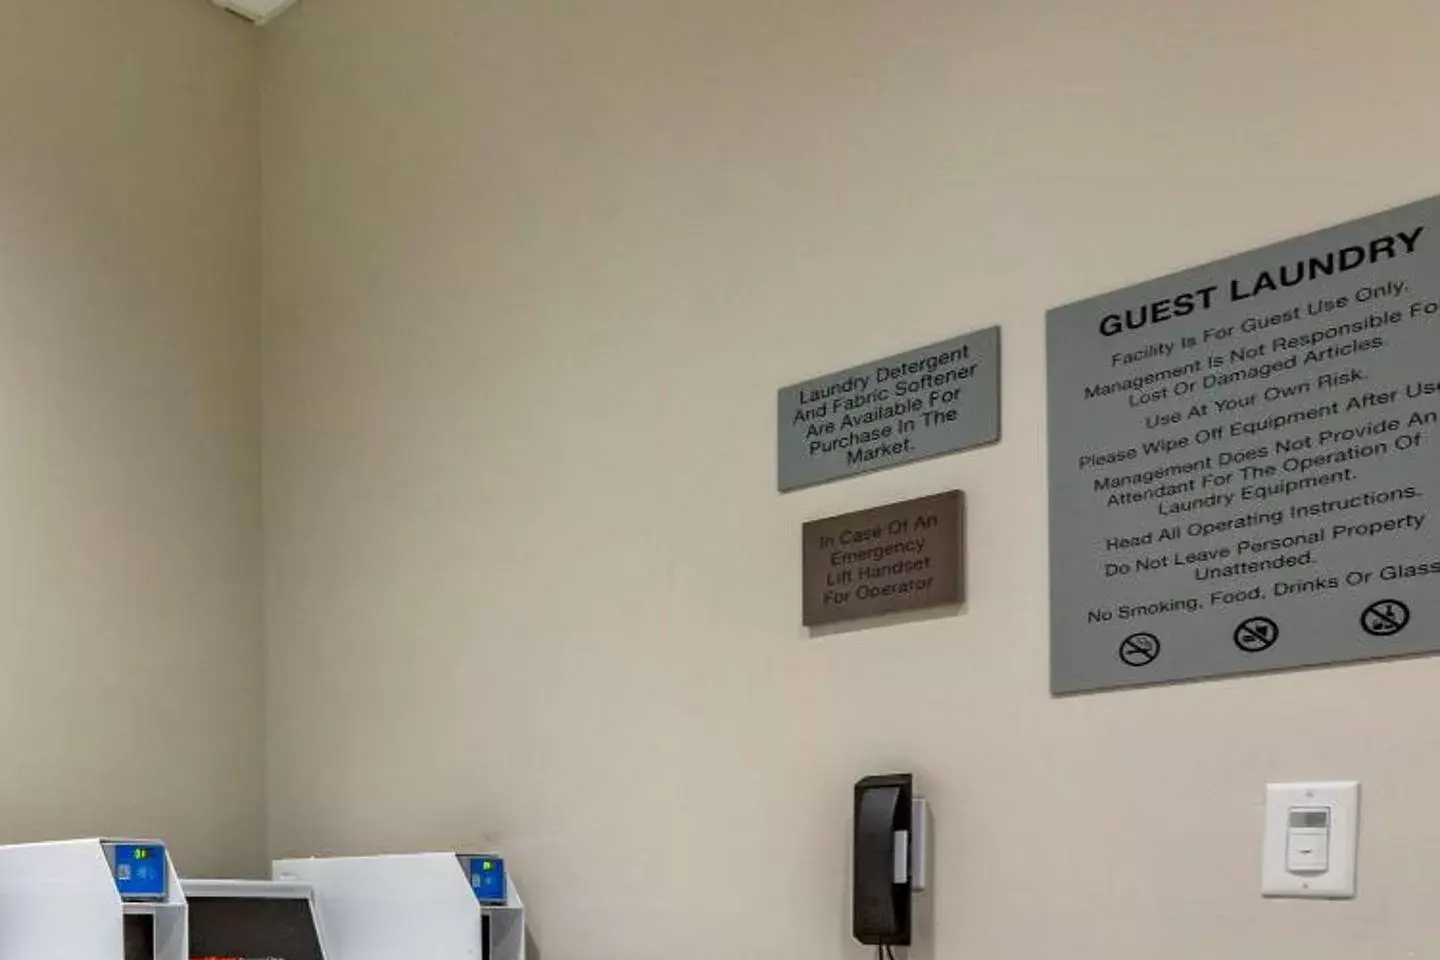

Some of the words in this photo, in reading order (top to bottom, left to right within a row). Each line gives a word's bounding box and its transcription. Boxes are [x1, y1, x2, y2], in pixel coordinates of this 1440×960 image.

[1099, 286, 1217, 337] GUEST
[1230, 226, 1424, 301] LAUNDRY
[1084, 359, 1203, 400] Management
[1207, 354, 1225, 369] Is
[1230, 345, 1265, 365] Not
[1272, 308, 1403, 353] Responsible
[1409, 297, 1440, 317] Fo
[1111, 340, 1174, 368] Facility
[1181, 336, 1197, 350] Is
[1203, 326, 1234, 344] For
[1241, 307, 1301, 333] Guest
[1307, 294, 1349, 316] Use
[1354, 279, 1410, 303] Only.
[793, 405, 827, 425] And
[832, 387, 888, 413] Fabric
[895, 362, 979, 397] Softener
[799, 374, 870, 405] Laundry
[876, 345, 969, 383] Detergent
[1128, 389, 1169, 408] Lost
[1173, 381, 1197, 397] Or
[1203, 358, 1297, 391] Damaged
[1145, 411, 1182, 430] Use
[1188, 404, 1210, 419] At
[1214, 394, 1256, 413] Your
[1264, 381, 1312, 401] Own
[1318, 367, 1369, 389] Risk.
[806, 422, 835, 439] Are
[839, 398, 923, 431] Available
[929, 389, 962, 407] For
[809, 426, 893, 455] Purchase
[898, 418, 915, 433] In
[923, 408, 957, 427] The
[1079, 448, 1138, 469] Please
[1143, 433, 1189, 456] Wipe
[1195, 425, 1223, 443] Off
[1229, 402, 1339, 437] Equipment
[1345, 388, 1398, 411] After
[1094, 456, 1213, 492] Management
[1218, 445, 1269, 466] Does
[1275, 437, 1313, 455] Not
[1318, 416, 1402, 445] Provide
[1408, 411, 1439, 427] An
[1107, 482, 1196, 508] Attendant
[1201, 472, 1233, 489] For
[1239, 463, 1277, 482] The
[1283, 443, 1388, 474] Operation
[1394, 432, 1422, 450] Of
[1158, 491, 1235, 517] Laundry
[1241, 468, 1357, 501] Equipment.
[1159, 526, 1181, 541] All
[1188, 509, 1284, 539] Operating
[1289, 486, 1423, 520] Instructions.
[819, 535, 835, 549] In
[839, 528, 881, 546] Case
[888, 518, 909, 534] Of
[914, 513, 938, 529] An
[830, 537, 926, 566] Emergency
[1105, 562, 1130, 578] Do
[1136, 555, 1169, 572] Not
[1174, 547, 1231, 567] Leave
[1238, 529, 1325, 557] Personal
[1332, 514, 1426, 541] Property
[822, 588, 850, 605] For
[855, 576, 933, 600] Operator
[826, 568, 853, 586] Lift
[858, 556, 931, 578] Handset
[1088, 609, 1113, 625] No
[1274, 576, 1339, 597] Drinks
[1345, 571, 1373, 587] Or
